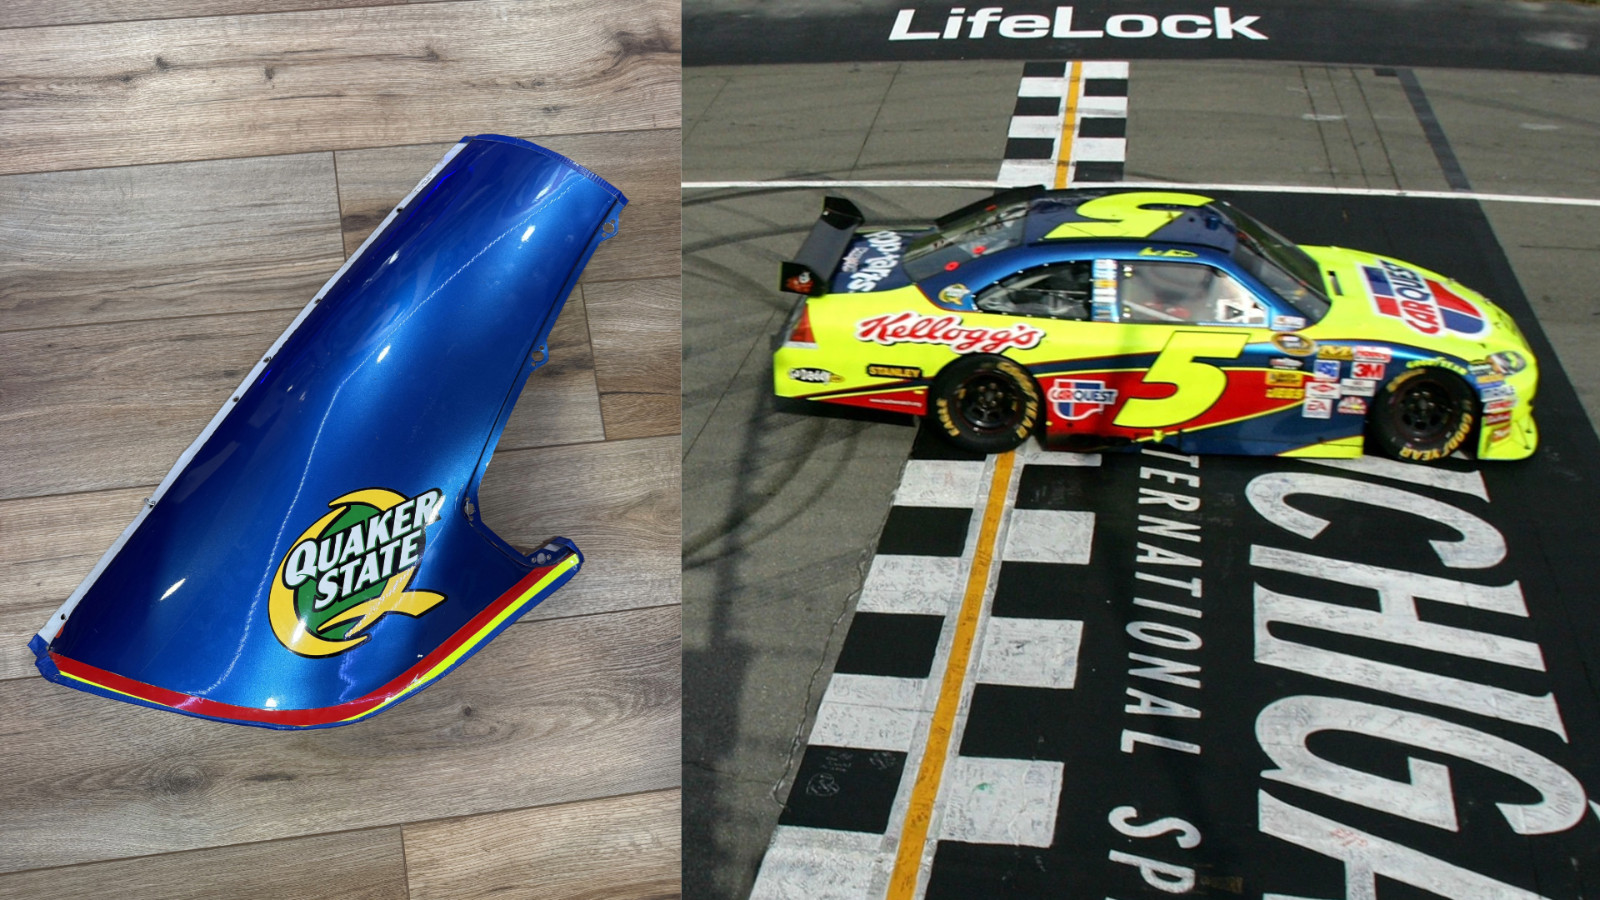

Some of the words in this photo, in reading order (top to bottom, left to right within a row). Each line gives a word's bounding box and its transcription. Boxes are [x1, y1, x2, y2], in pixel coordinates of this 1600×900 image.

[888, 6, 1268, 41] LifeLock
[860, 313, 1038, 352] Kellogg's
[869, 366, 920, 378] STANLEY
[1113, 331, 1250, 428] 5
[1354, 363, 1384, 378] 3M
[285, 490, 445, 587] QUAKER
[314, 530, 422, 610] STATE
[1107, 805, 1202, 900] SP
